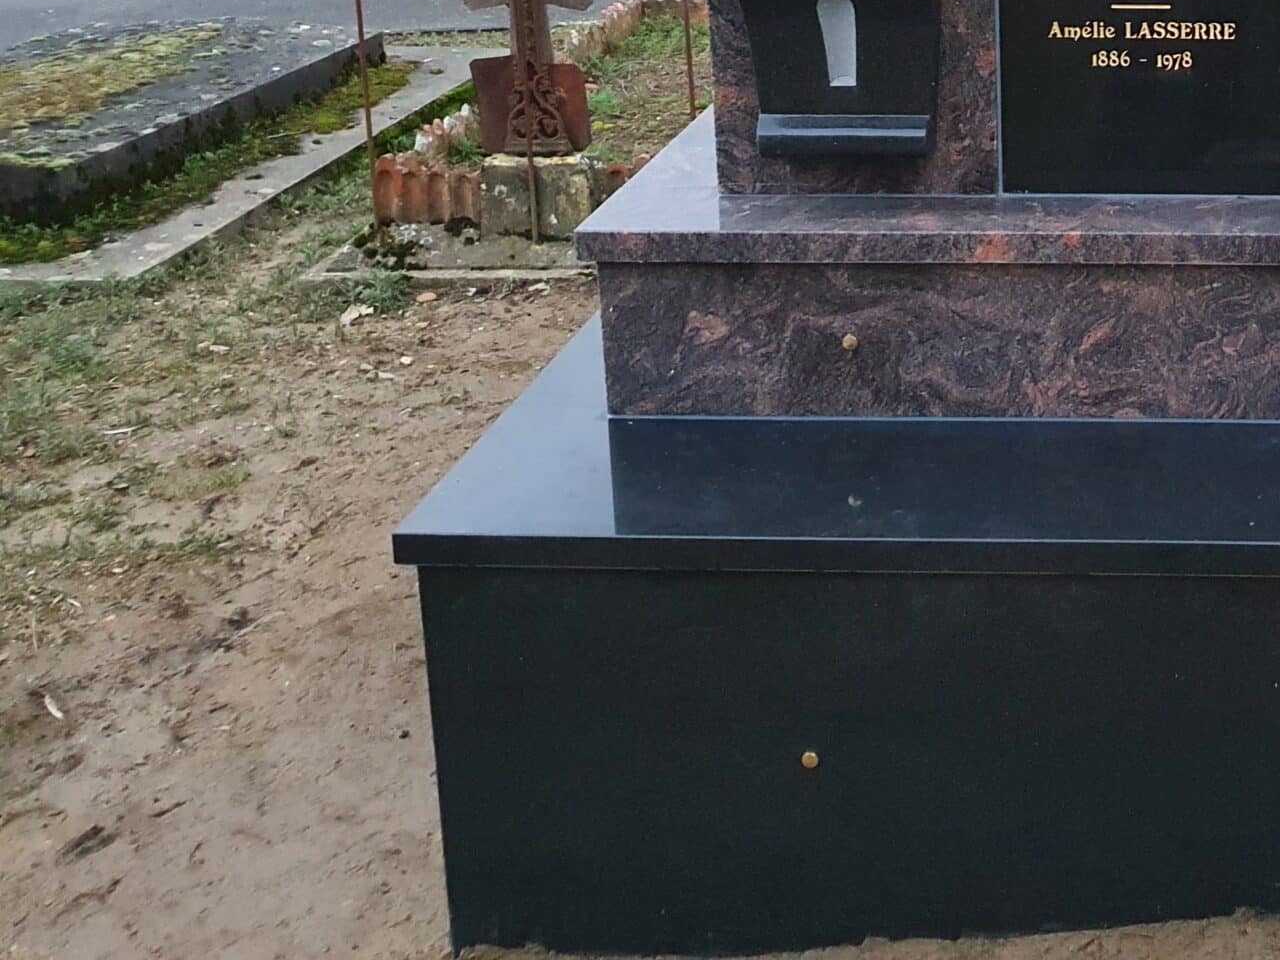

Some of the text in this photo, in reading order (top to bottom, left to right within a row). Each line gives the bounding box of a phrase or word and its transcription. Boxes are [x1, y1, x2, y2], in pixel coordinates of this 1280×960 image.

[1048, 21, 1236, 41] Amélie LASSERRE
[1091, 50, 1131, 67] 1886
[1156, 51, 1193, 70] 1978
